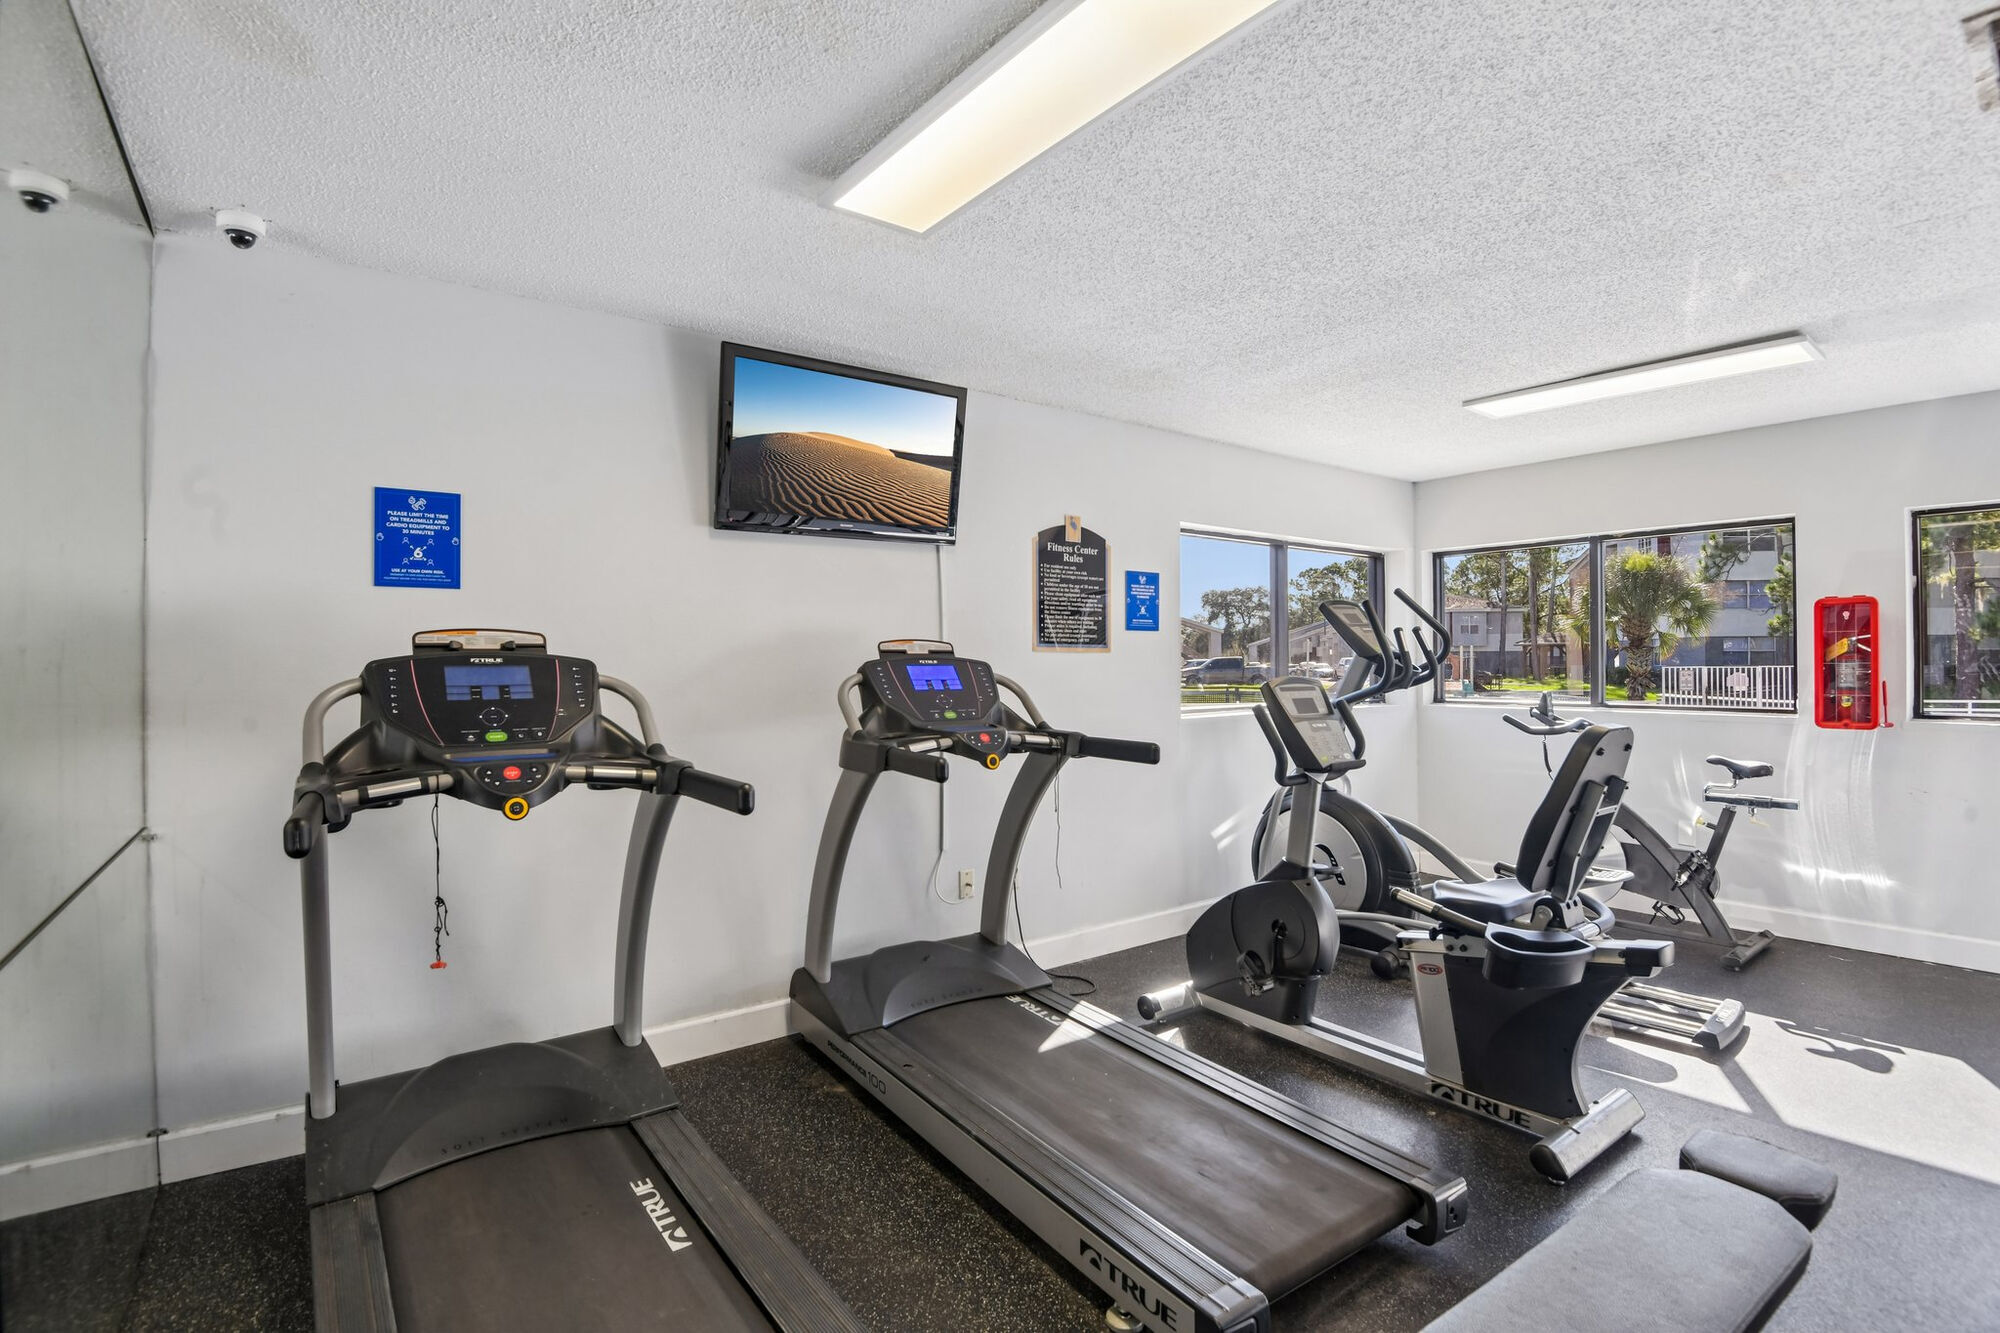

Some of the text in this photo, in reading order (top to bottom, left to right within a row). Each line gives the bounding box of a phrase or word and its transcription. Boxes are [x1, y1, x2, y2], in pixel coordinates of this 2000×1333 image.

[414, 547, 423, 558] 6
[1047, 542, 1098, 555] Fitness Center
[1064, 553, 1083, 563] Rules
[868, 1072, 886, 1095] 100
[1456, 1090, 1530, 1129] TRUE
[630, 1178, 676, 1232] TRUE
[1104, 1257, 1177, 1332] TRUE
